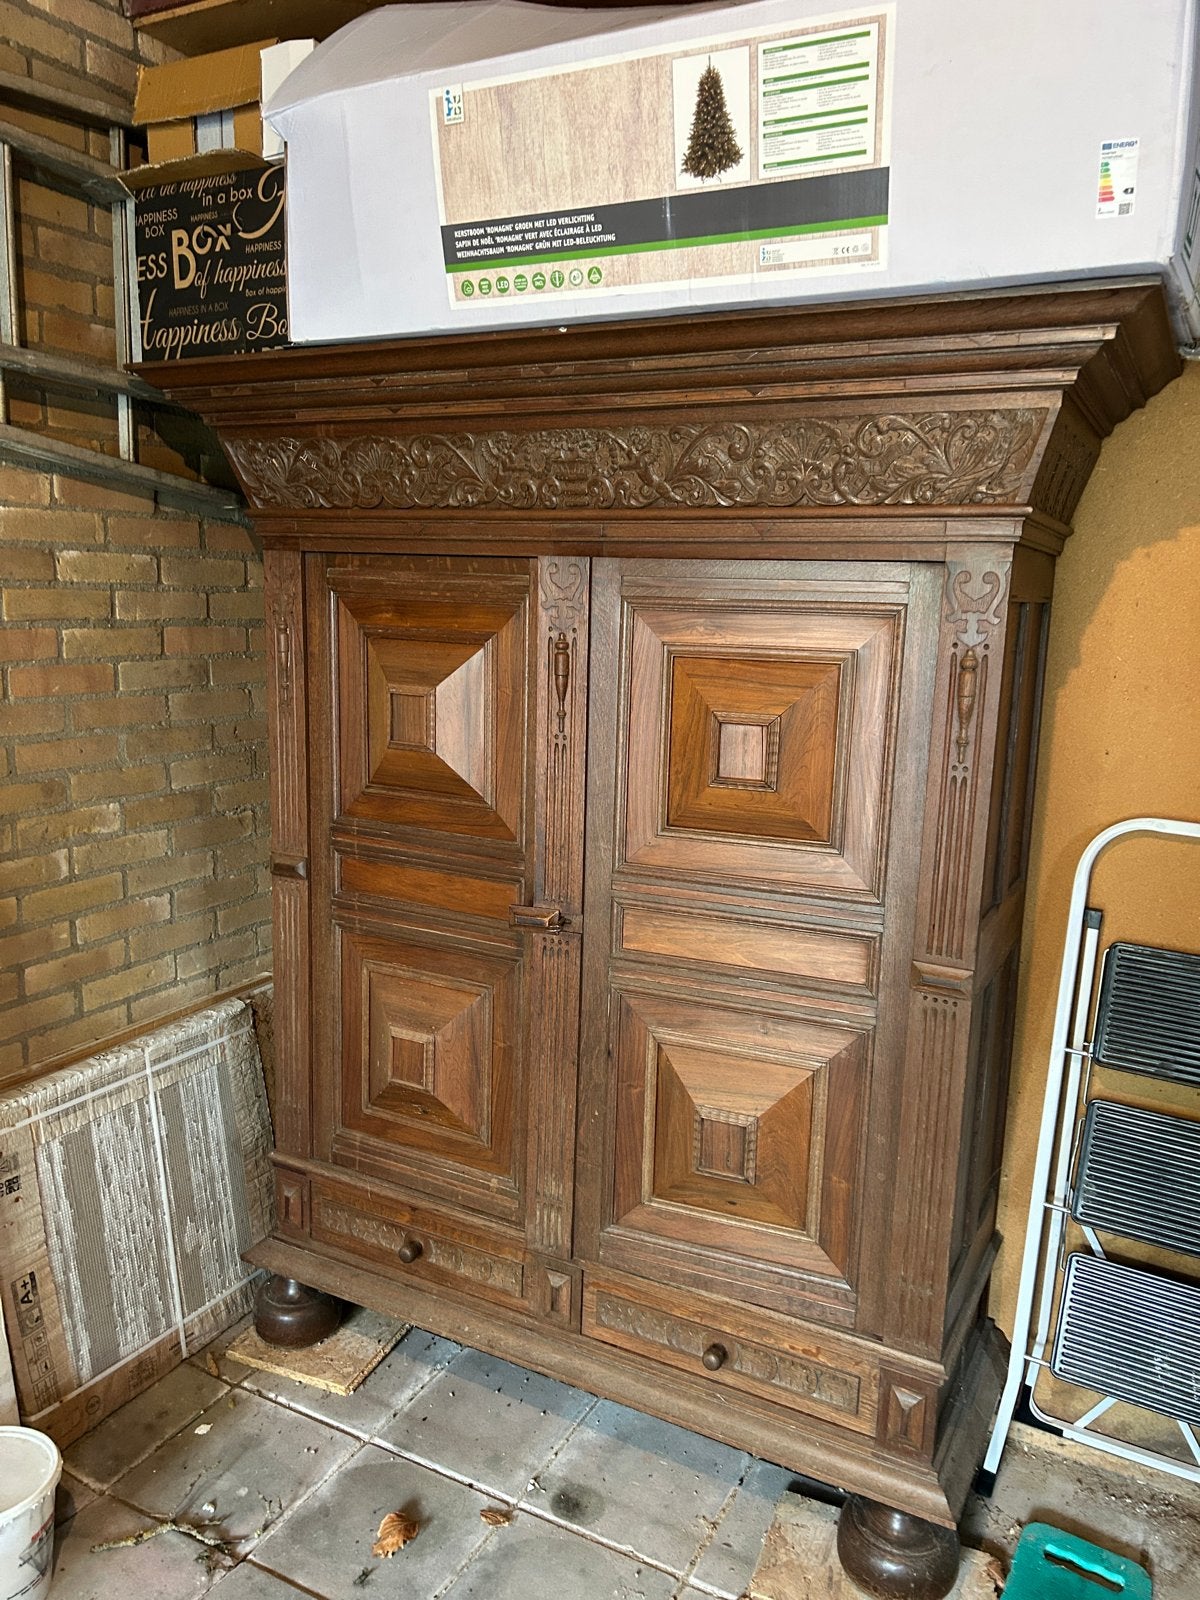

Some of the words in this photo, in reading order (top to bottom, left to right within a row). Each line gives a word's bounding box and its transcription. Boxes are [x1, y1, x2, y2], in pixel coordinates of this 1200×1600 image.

[202, 193, 213, 207] in
[217, 193, 226, 204] a
[230, 187, 253, 202] box
[190, 210, 219, 223] HAPPINESS
[145, 224, 165, 238] BOX
[454, 228, 485, 238] KERSTBOOM
[515, 221, 533, 231] GROEN
[534, 219, 546, 228] MET
[546, 218, 557, 227] LED
[558, 213, 595, 225] VERLICHTING
[455, 240, 472, 249] SAPIN
[473, 238, 480, 247] DE
[481, 236, 495, 246] NOËL
[525, 232, 538, 240] VERT
[539, 229, 553, 238] AVEC
[554, 226, 585, 237] ÉCLAIRAGE
[586, 223, 591, 233] À
[591, 223, 603, 232] LED
[535, 240, 551, 250] GRÜN
[552, 239, 562, 248] MIT
[563, 233, 616, 247] LED-BELEUCHTUNG
[245, 240, 282, 255] HAPPINESS
[171, 223, 232, 290] BOX
[194, 259, 212, 299] of
[213, 258, 286, 292] happiness
[496, 280, 508, 289] LED
[245, 288, 257, 297] Box
[257, 286, 266, 296] of
[168, 304, 200, 317] HAPPINESS
[201, 303, 208, 313] IN
[208, 303, 214, 313] A
[214, 301, 229, 313] BOX
